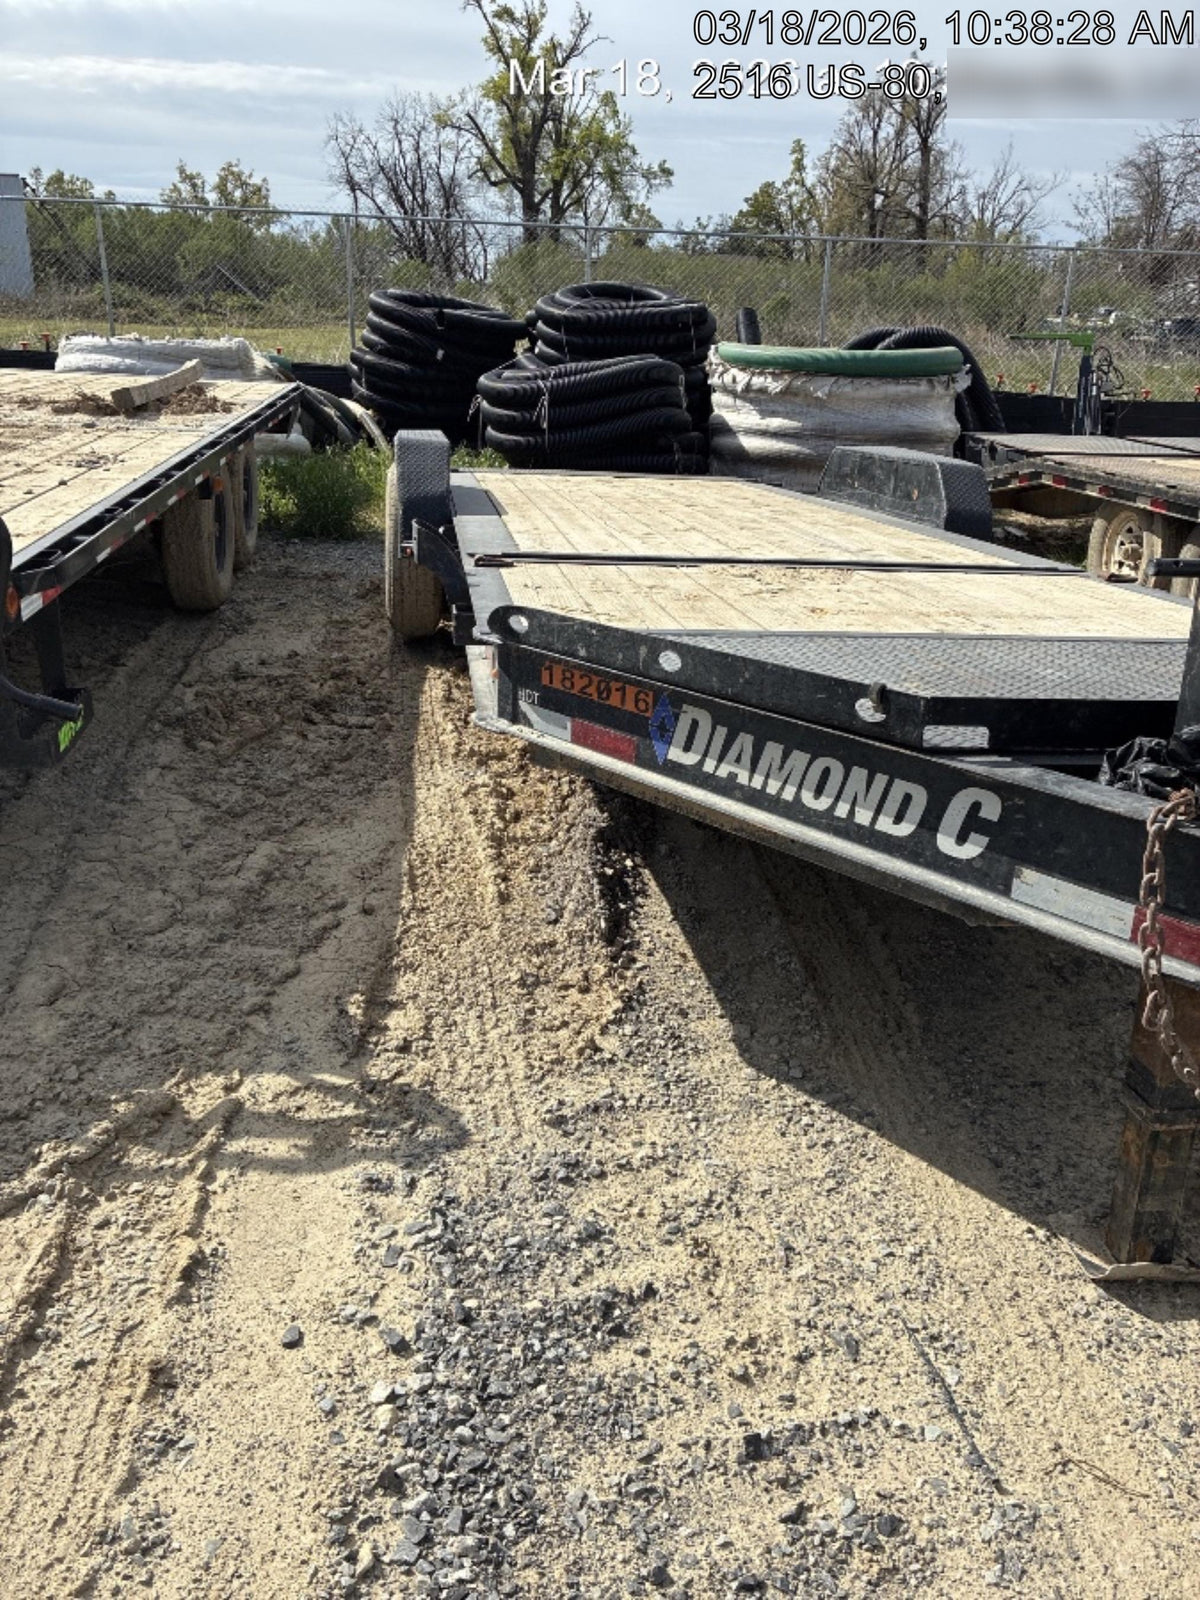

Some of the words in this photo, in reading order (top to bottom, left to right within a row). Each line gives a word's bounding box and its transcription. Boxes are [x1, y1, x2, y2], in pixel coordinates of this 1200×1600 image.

[541, 663, 652, 714] 182016
[666, 703, 928, 838] DIAMOND
[936, 786, 1002, 861] C
